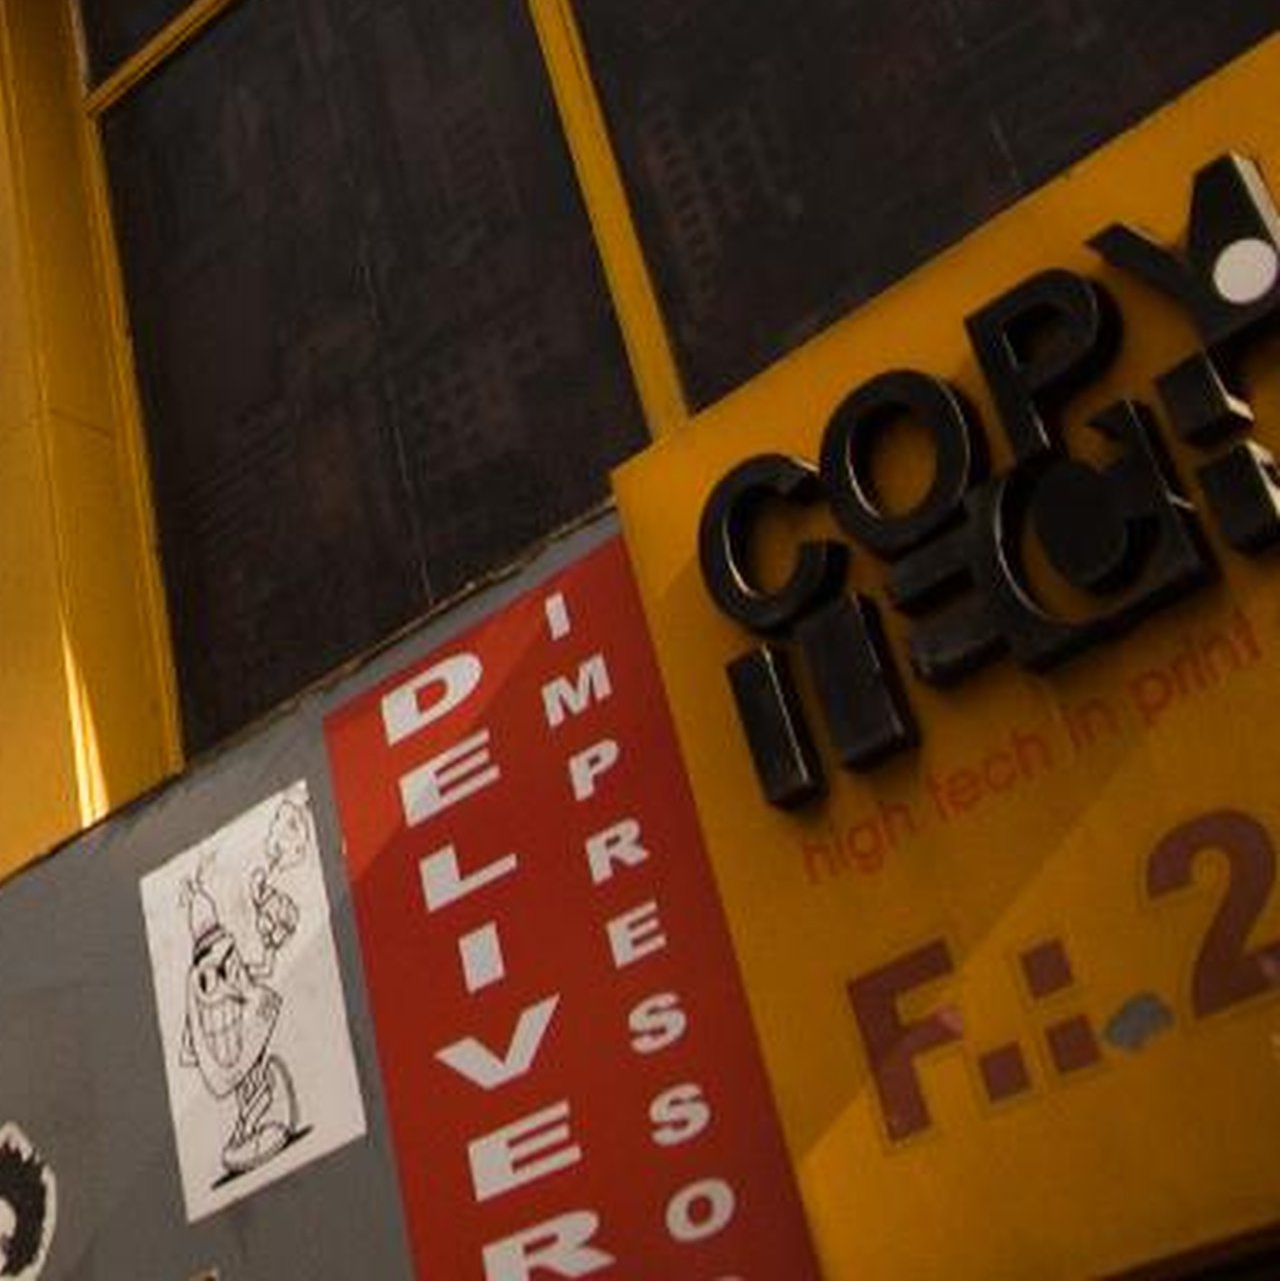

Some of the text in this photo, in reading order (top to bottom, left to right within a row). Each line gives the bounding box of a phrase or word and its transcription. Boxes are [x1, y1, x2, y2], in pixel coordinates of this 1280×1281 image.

[699, 151, 1280, 631] COPY
[379, 651, 616, 1281] DELIVER
[541, 593, 745, 1281] IMPRESSO
[802, 607, 1262, 885] high tech in print
